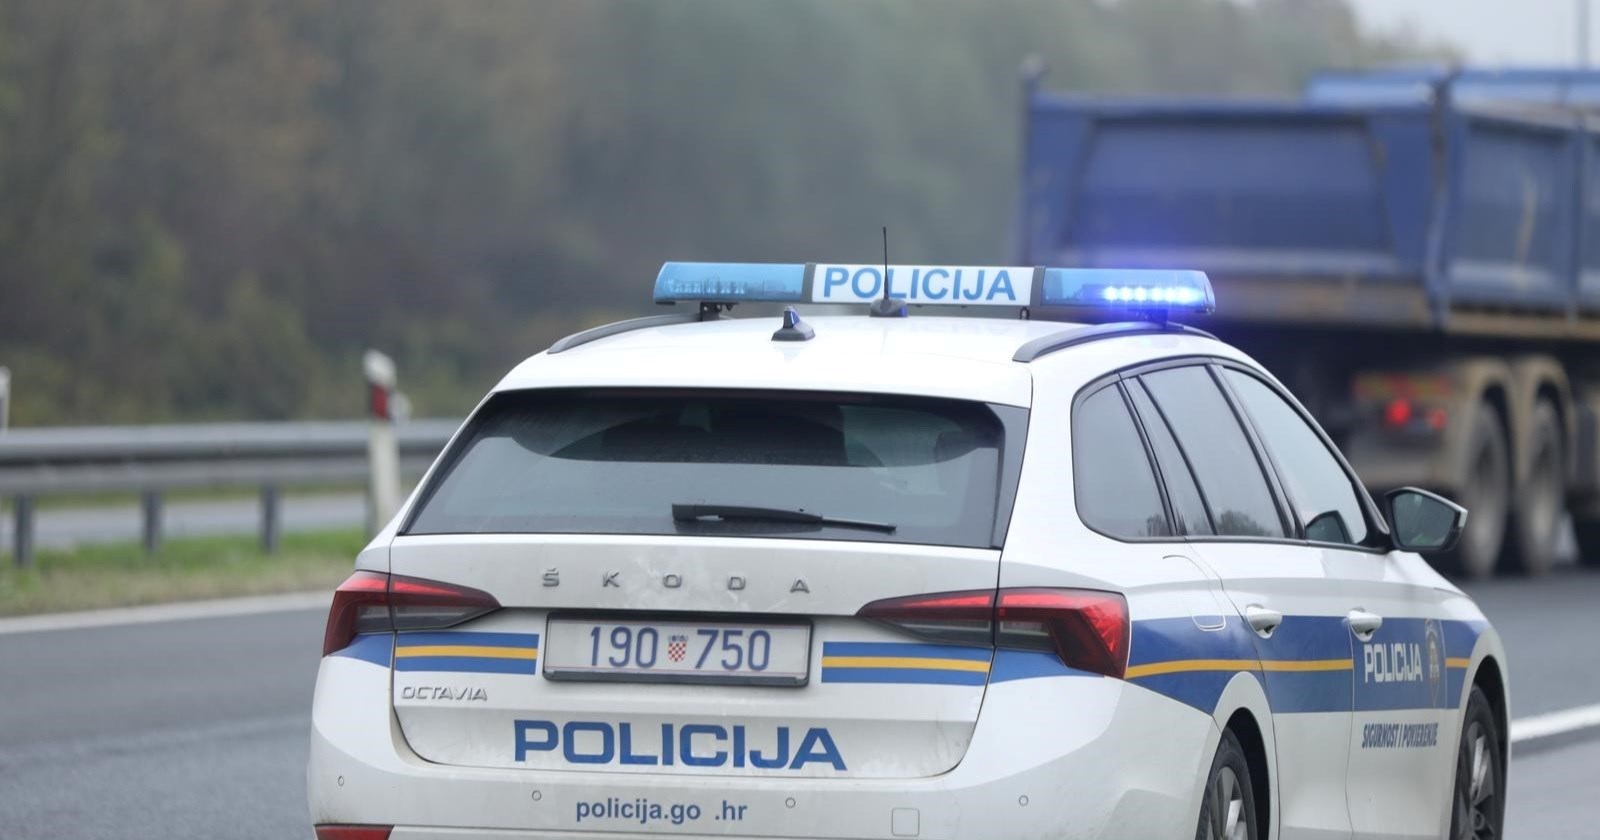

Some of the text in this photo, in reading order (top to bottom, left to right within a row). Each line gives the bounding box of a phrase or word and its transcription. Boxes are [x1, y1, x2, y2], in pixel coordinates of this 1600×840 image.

[823, 267, 1016, 301] POLICIJA
[541, 568, 810, 594] ŠKODA
[589, 626, 771, 671] 190 750
[1364, 643, 1423, 683] POLICIJA
[401, 685, 487, 701] OCTAVIA
[514, 719, 847, 771] POLICIJA
